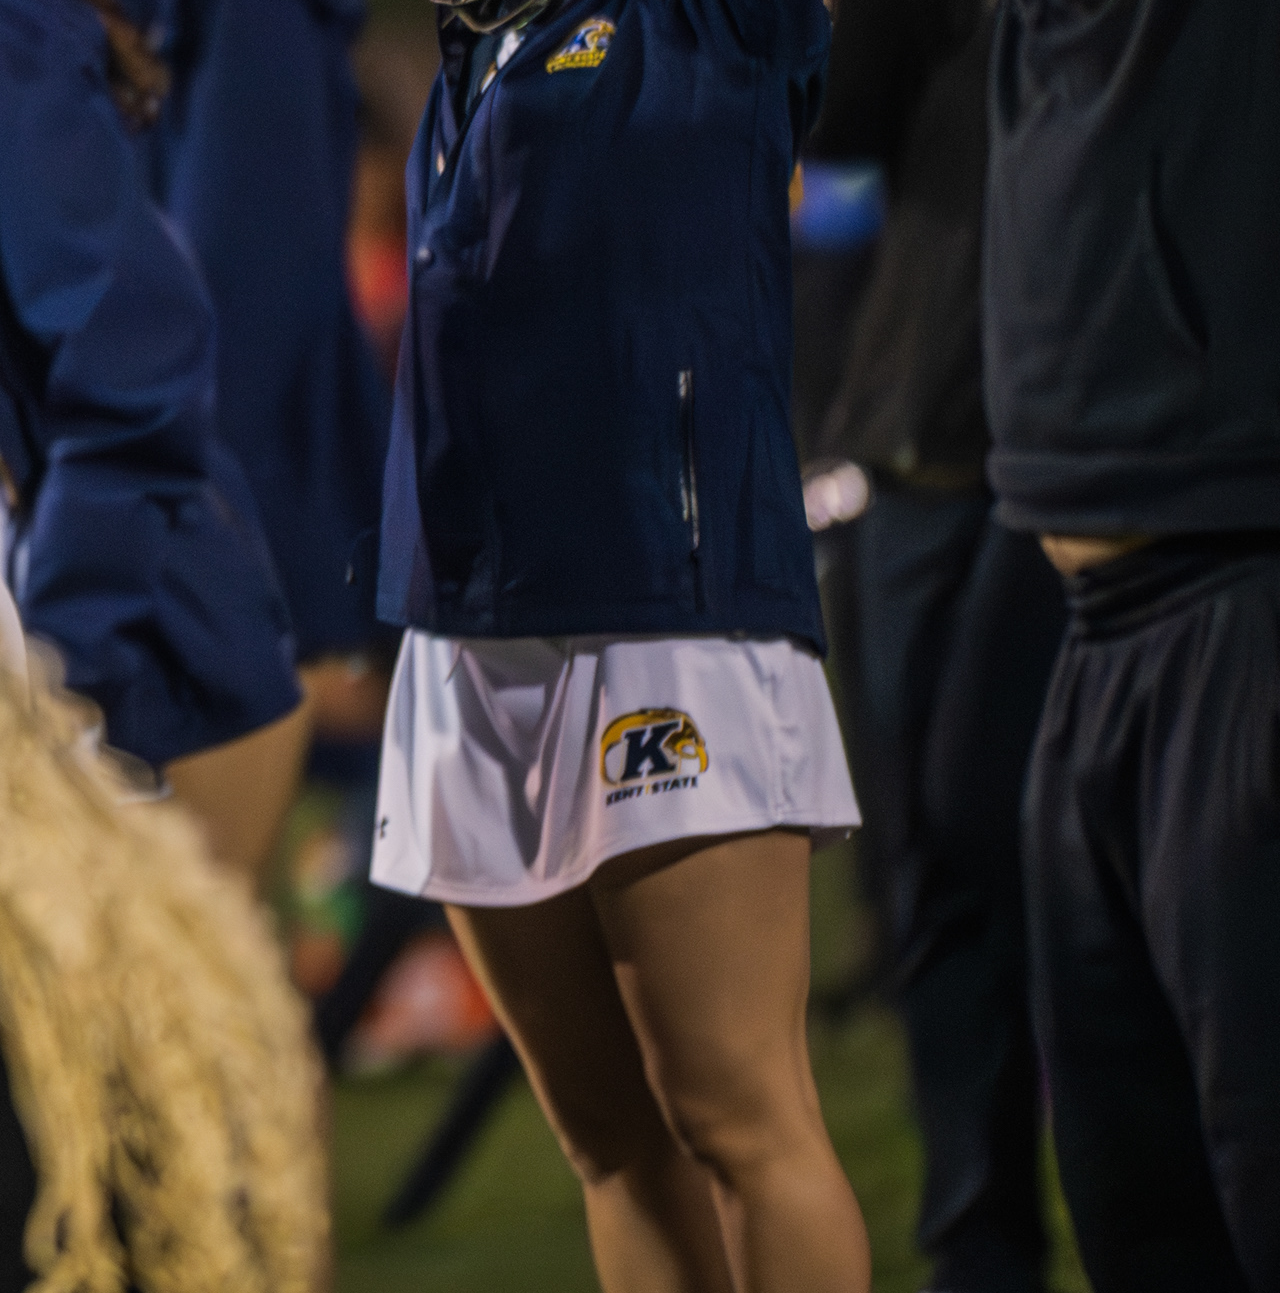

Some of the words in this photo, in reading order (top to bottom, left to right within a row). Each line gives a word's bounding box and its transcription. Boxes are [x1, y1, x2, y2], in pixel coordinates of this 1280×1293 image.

[620, 719, 683, 783] K
[606, 785, 644, 807] KENT
[651, 775, 699, 794] STATE
